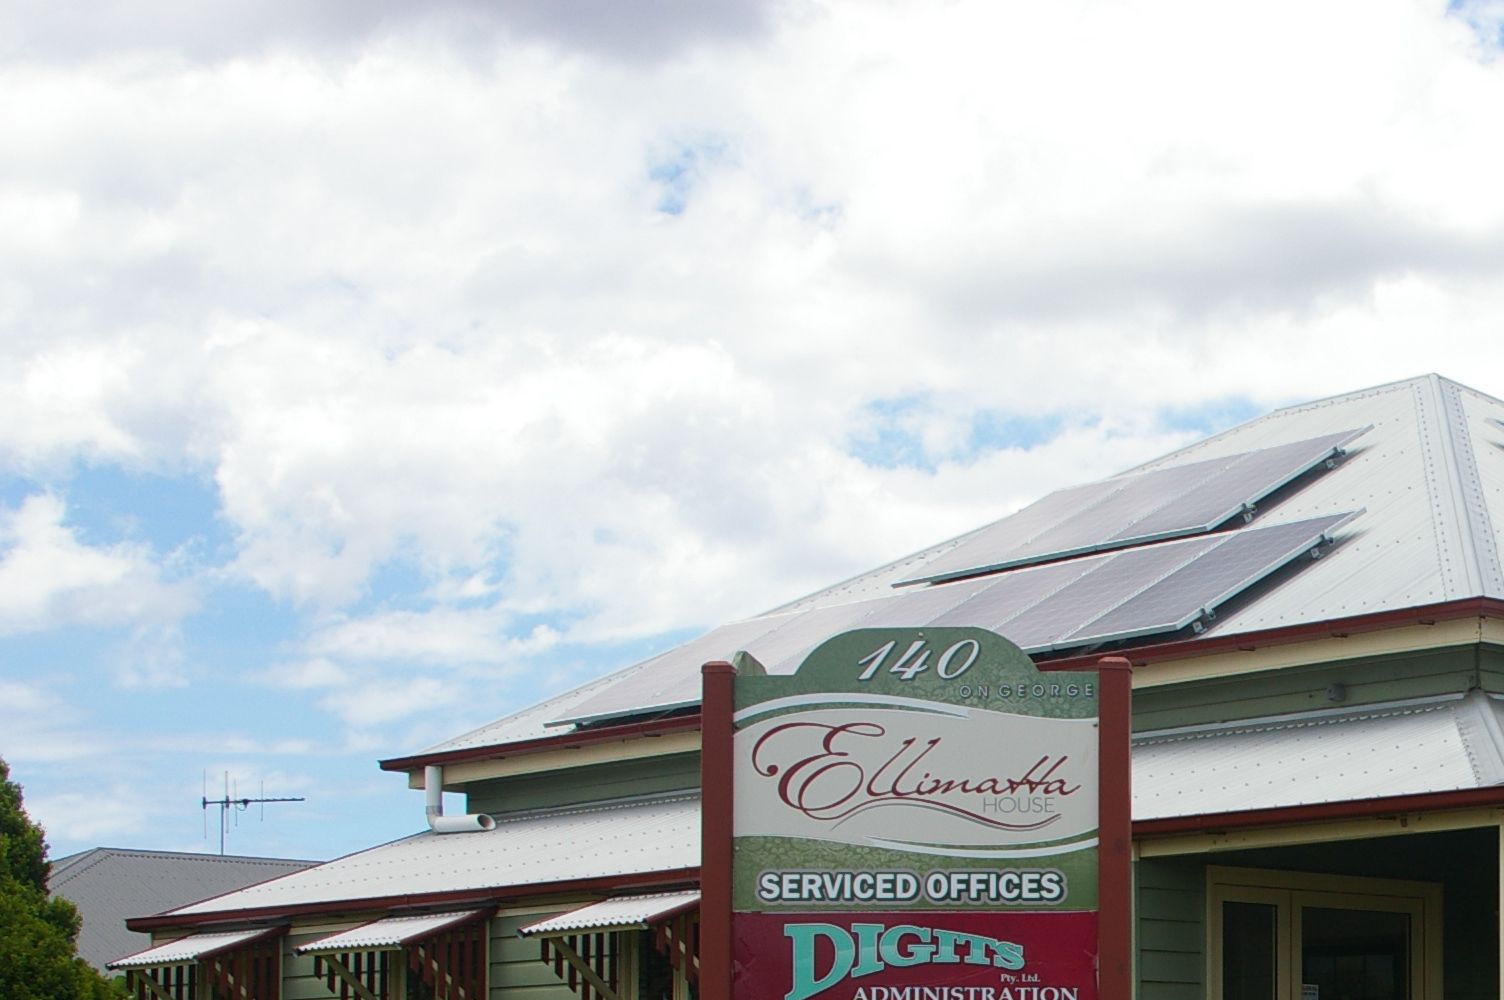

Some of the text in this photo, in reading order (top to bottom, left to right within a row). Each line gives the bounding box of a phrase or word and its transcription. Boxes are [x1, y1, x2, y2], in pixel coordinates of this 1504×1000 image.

[858, 638, 981, 681] 140
[959, 682, 1094, 699] ON GEORGE
[752, 721, 1082, 820] Ellimatta
[983, 796, 1056, 814] HOUSE
[759, 871, 1064, 901] SERVICED OFFICES
[1021, 973, 1041, 982] Ltd.
